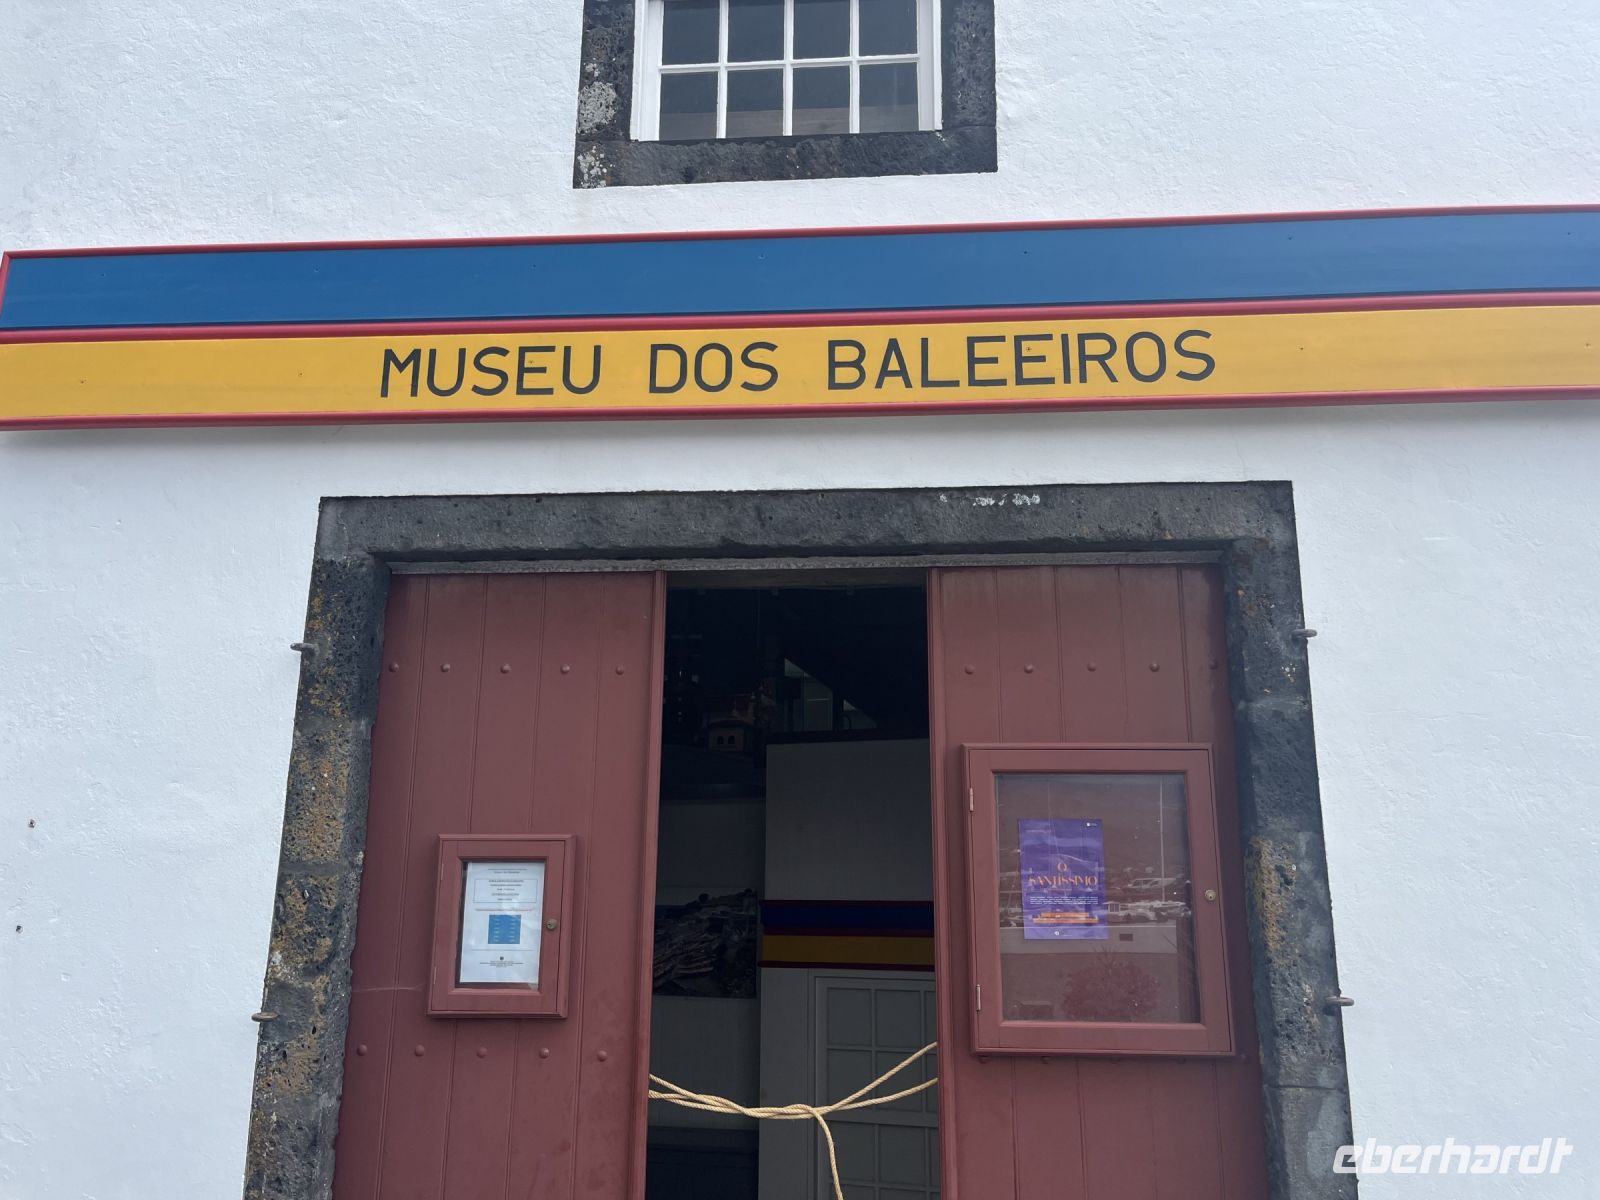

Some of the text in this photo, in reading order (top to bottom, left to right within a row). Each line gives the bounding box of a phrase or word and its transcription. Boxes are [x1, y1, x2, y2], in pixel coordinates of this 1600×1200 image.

[381, 330, 1215, 397] MUSEU DOS BALEEIROS
[1057, 862, 1067, 872] O
